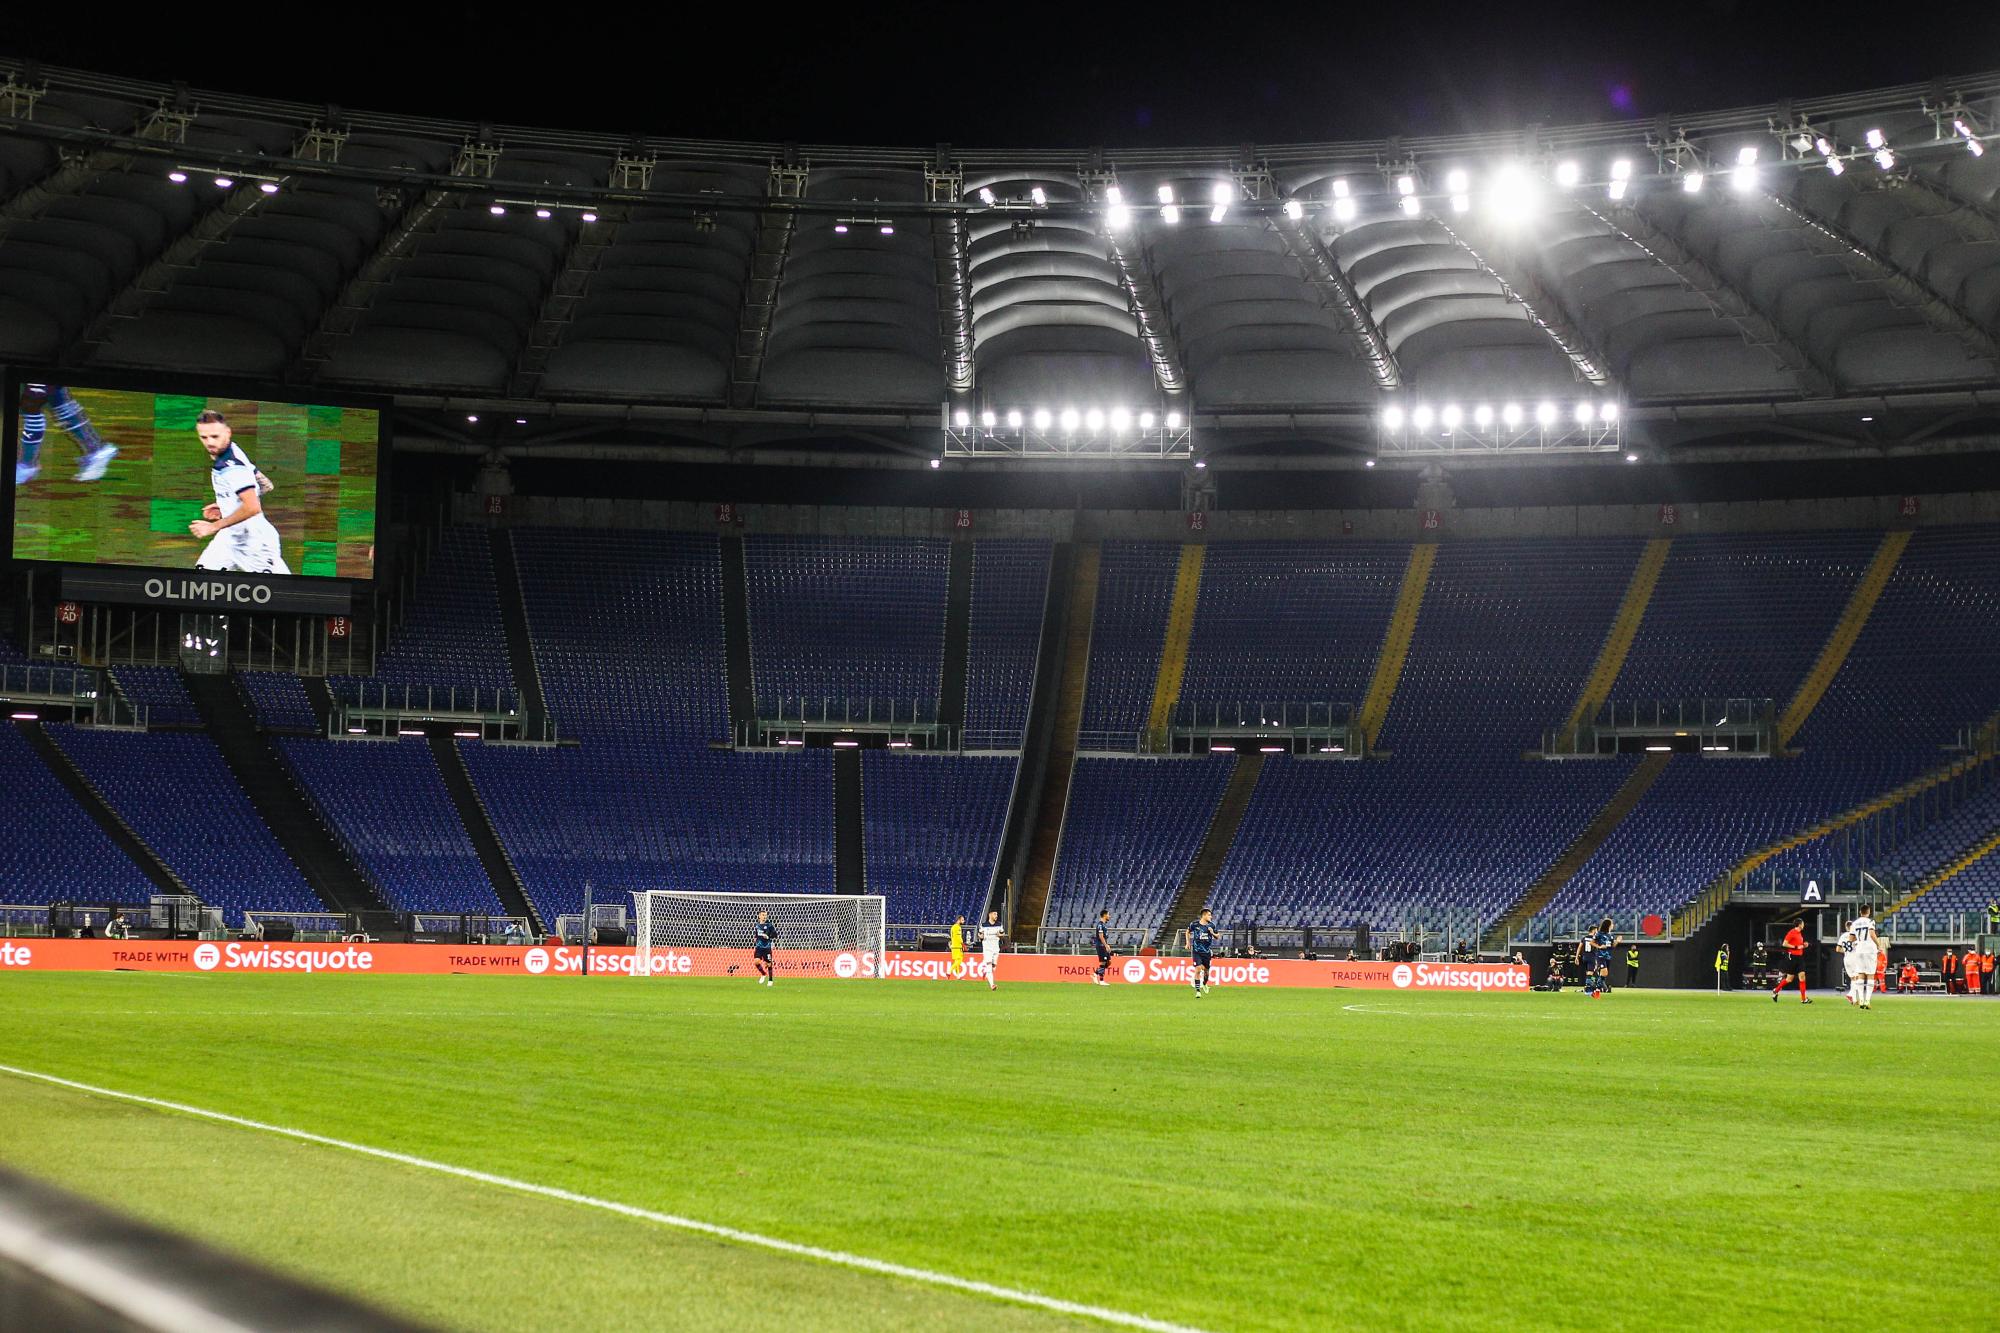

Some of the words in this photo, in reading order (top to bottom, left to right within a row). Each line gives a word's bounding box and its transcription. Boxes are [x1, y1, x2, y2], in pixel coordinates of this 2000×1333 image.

[489, 505, 502, 514] AD
[720, 504, 730, 513] 18
[959, 509, 969, 518] 18
[1192, 512, 1202, 521] 17
[1427, 511, 1436, 520] 17
[957, 518, 970, 527] AD
[1191, 521, 1202, 530] AS
[1424, 520, 1438, 529] AD
[144, 578, 272, 604] OLIMPICO
[64, 601, 76, 611] 20
[62, 611, 77, 622] AD
[334, 616, 345, 626] 19
[332, 626, 345, 636] AS
[1803, 880, 1822, 901] A
[1855, 926, 1869, 942] 77
[0, 942, 31, 966] te
[112, 951, 152, 962] TRADE
[155, 952, 188, 963] WITH
[225, 942, 373, 973] Swissquote
[449, 956, 487, 966] TRADE
[489, 957, 520, 967] WITH
[554, 947, 692, 977] Swissquote
[1058, 966, 1090, 976] TRADE
[1149, 958, 1270, 985] Swisquote
[1331, 971, 1362, 981] TRADE
[1364, 972, 1389, 982] WITH
[1416, 963, 1527, 990] Swissquote
